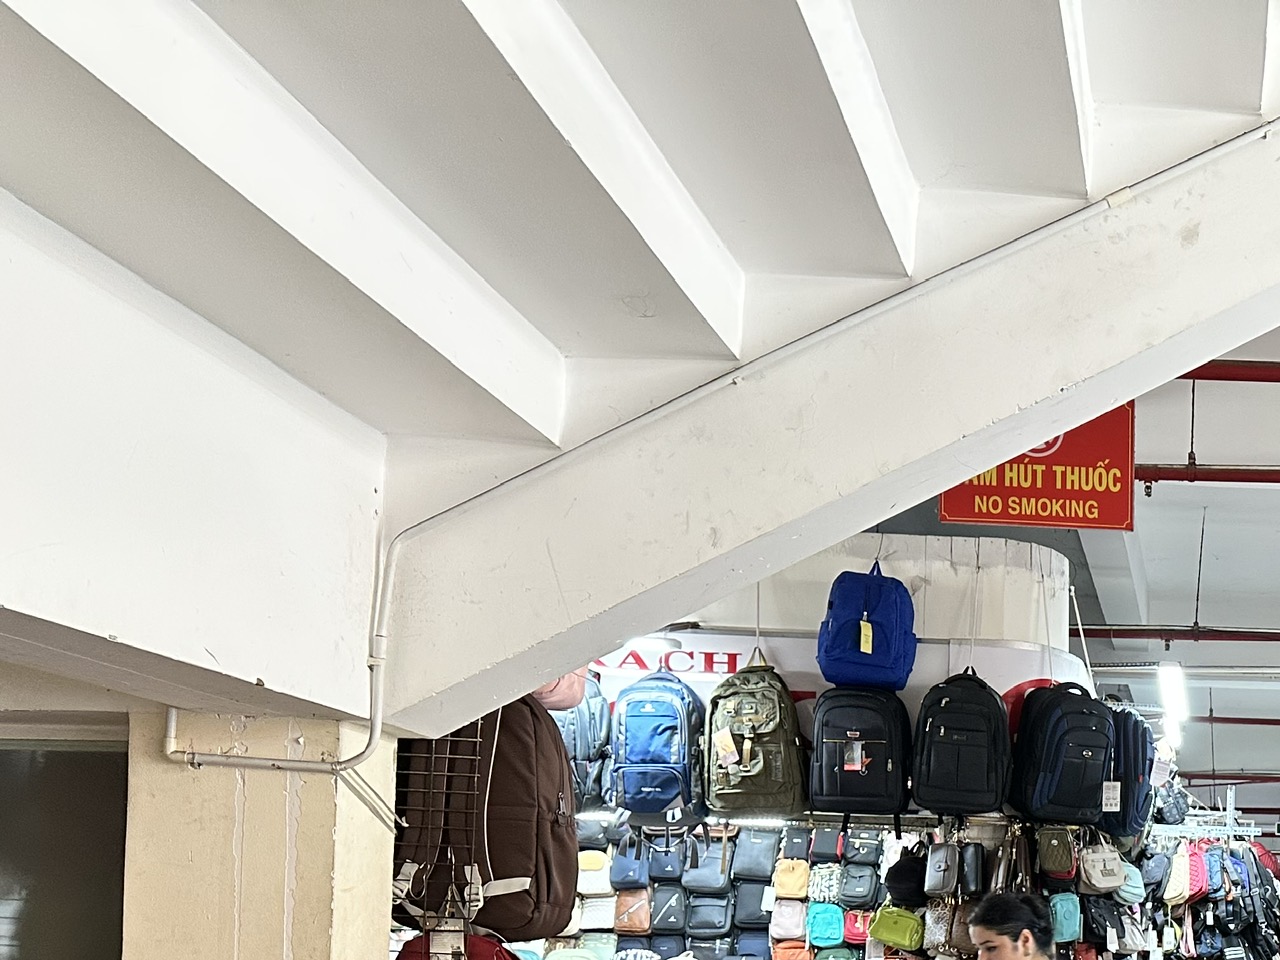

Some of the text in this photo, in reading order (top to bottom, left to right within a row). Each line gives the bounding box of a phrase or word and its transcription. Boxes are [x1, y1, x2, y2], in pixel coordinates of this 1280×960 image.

[1004, 458, 1046, 489] HÚT
[1052, 459, 1122, 493] THUỐC
[974, 495, 1099, 519] NO SMOKING
